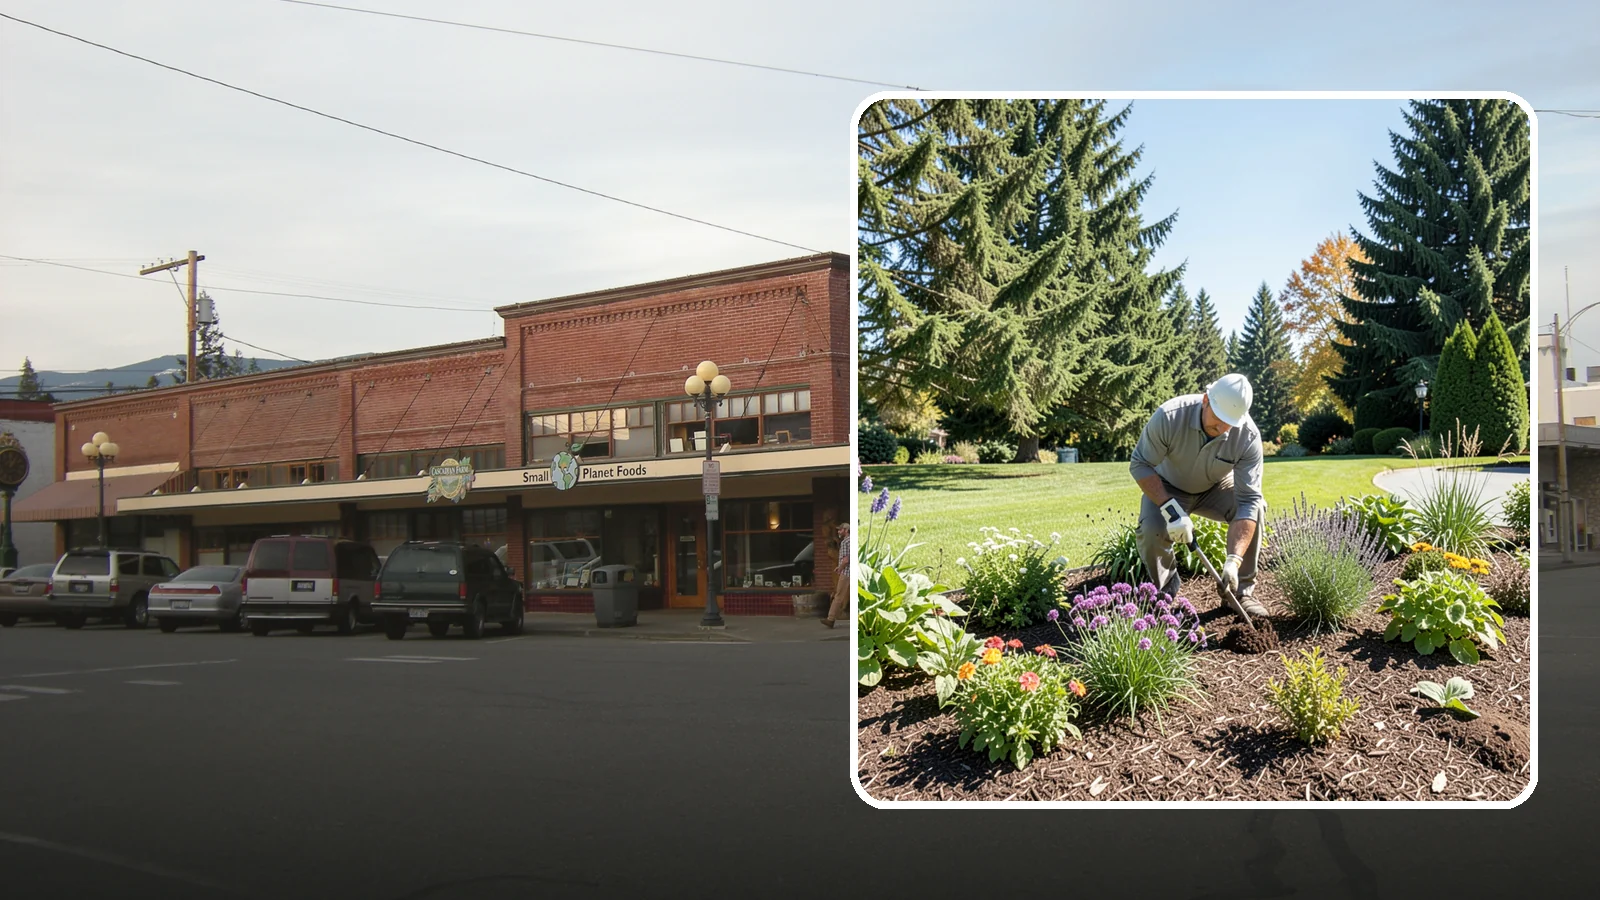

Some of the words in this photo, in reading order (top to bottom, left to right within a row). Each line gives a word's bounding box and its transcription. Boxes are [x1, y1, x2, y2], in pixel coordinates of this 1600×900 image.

[523, 471, 549, 483] Small
[582, 467, 614, 479] Planet
[617, 464, 647, 477] Foods
